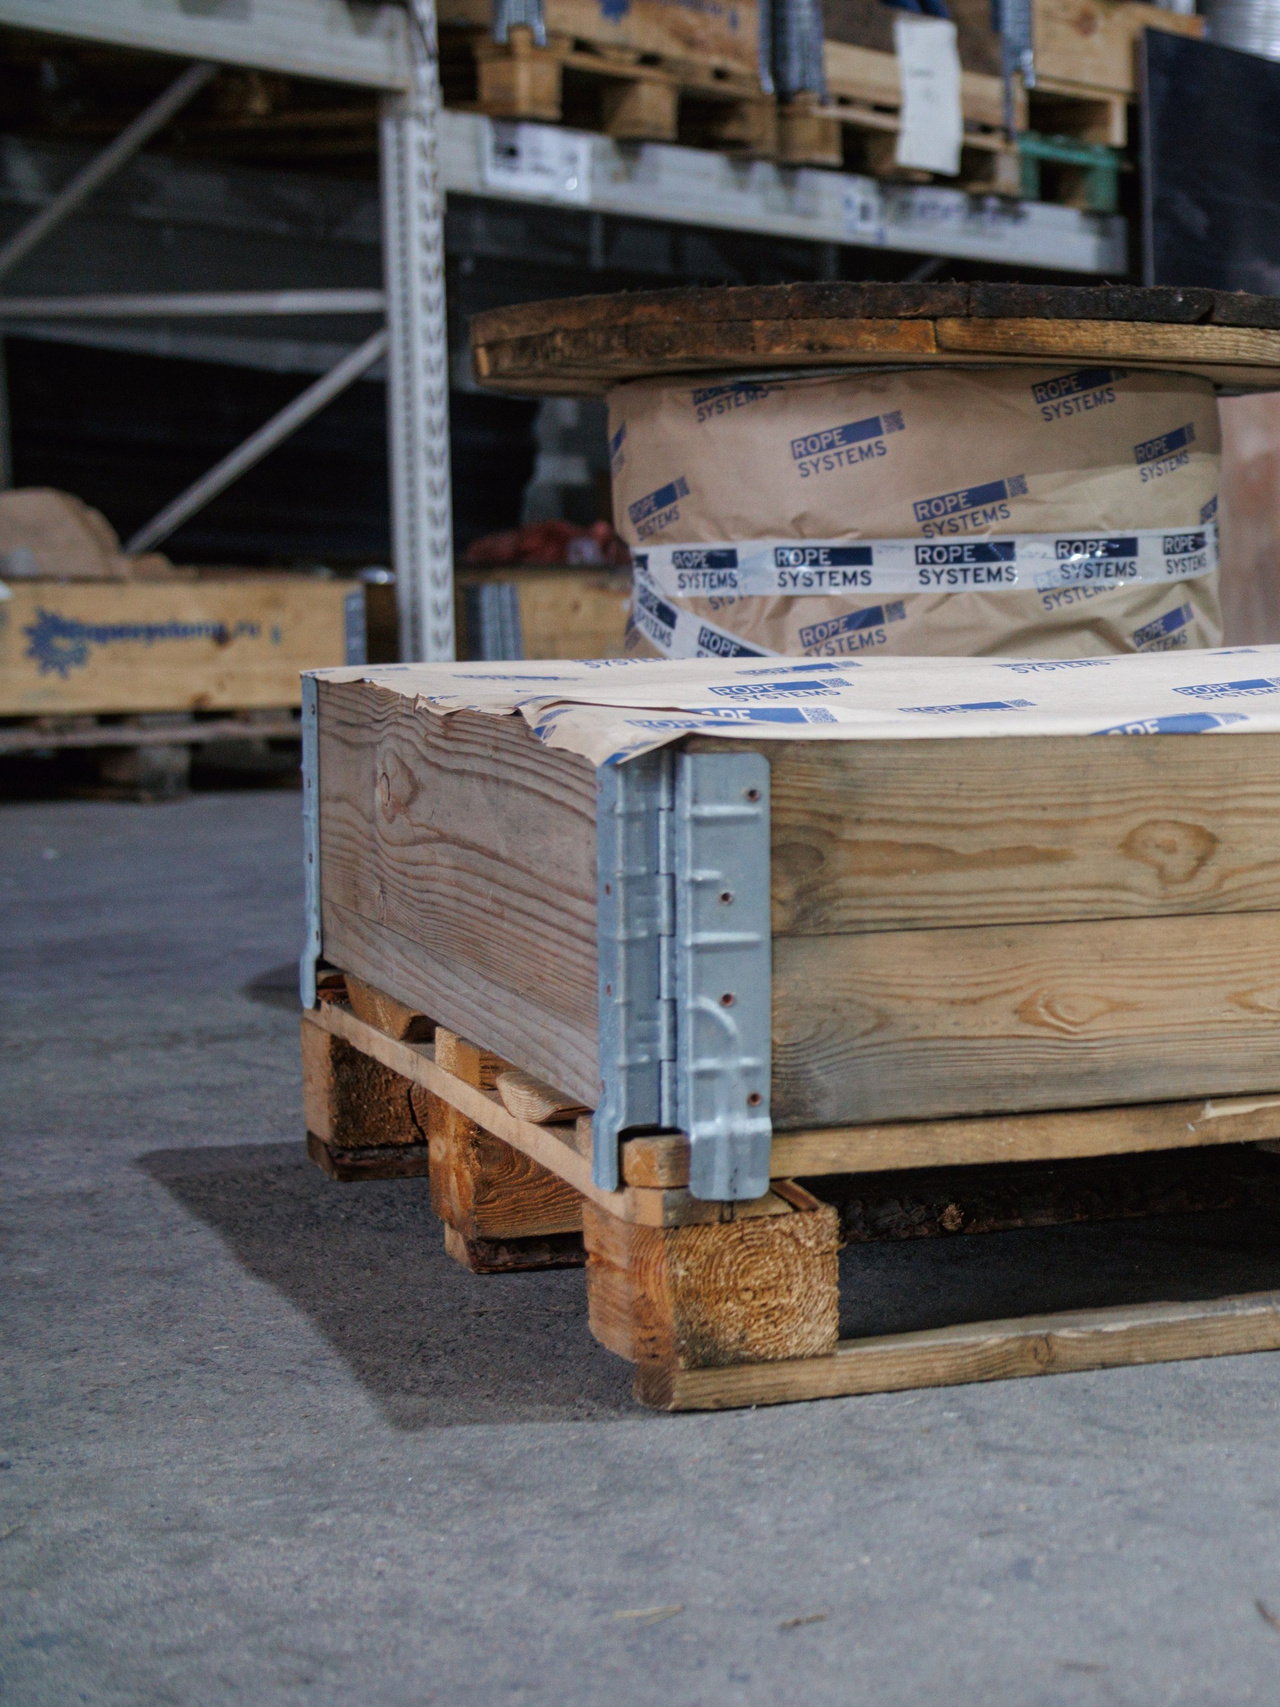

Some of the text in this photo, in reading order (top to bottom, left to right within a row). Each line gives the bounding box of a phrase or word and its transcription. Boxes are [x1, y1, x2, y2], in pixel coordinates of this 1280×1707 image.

[1034, 375, 1080, 403] ROPE
[1041, 387, 1117, 422] SYSTEMS
[792, 428, 847, 460] ROPE
[1135, 438, 1169, 464] ROPE
[798, 440, 888, 478] SYSTEMS
[1140, 450, 1190, 483] SYSTEMS
[915, 491, 971, 521] ROPE
[921, 504, 1012, 539] SYSTEMS
[916, 545, 977, 564] ROPE
[1056, 540, 1108, 560] ROPE
[1163, 536, 1195, 554] ROPE
[673, 550, 710, 569] ROPE
[776, 548, 831, 566] ROPE
[678, 571, 738, 589] SYSTEMS
[777, 570, 872, 588] SYSTEMS
[918, 565, 1017, 586] SYSTEMS
[1060, 561, 1138, 580] SYSTEMS
[698, 625, 741, 657] ROPE
[800, 616, 850, 647] ROPE
[711, 683, 784, 697] ROPE
[729, 689, 842, 702] SYSTEMS
[1176, 683, 1239, 696] ROPE
